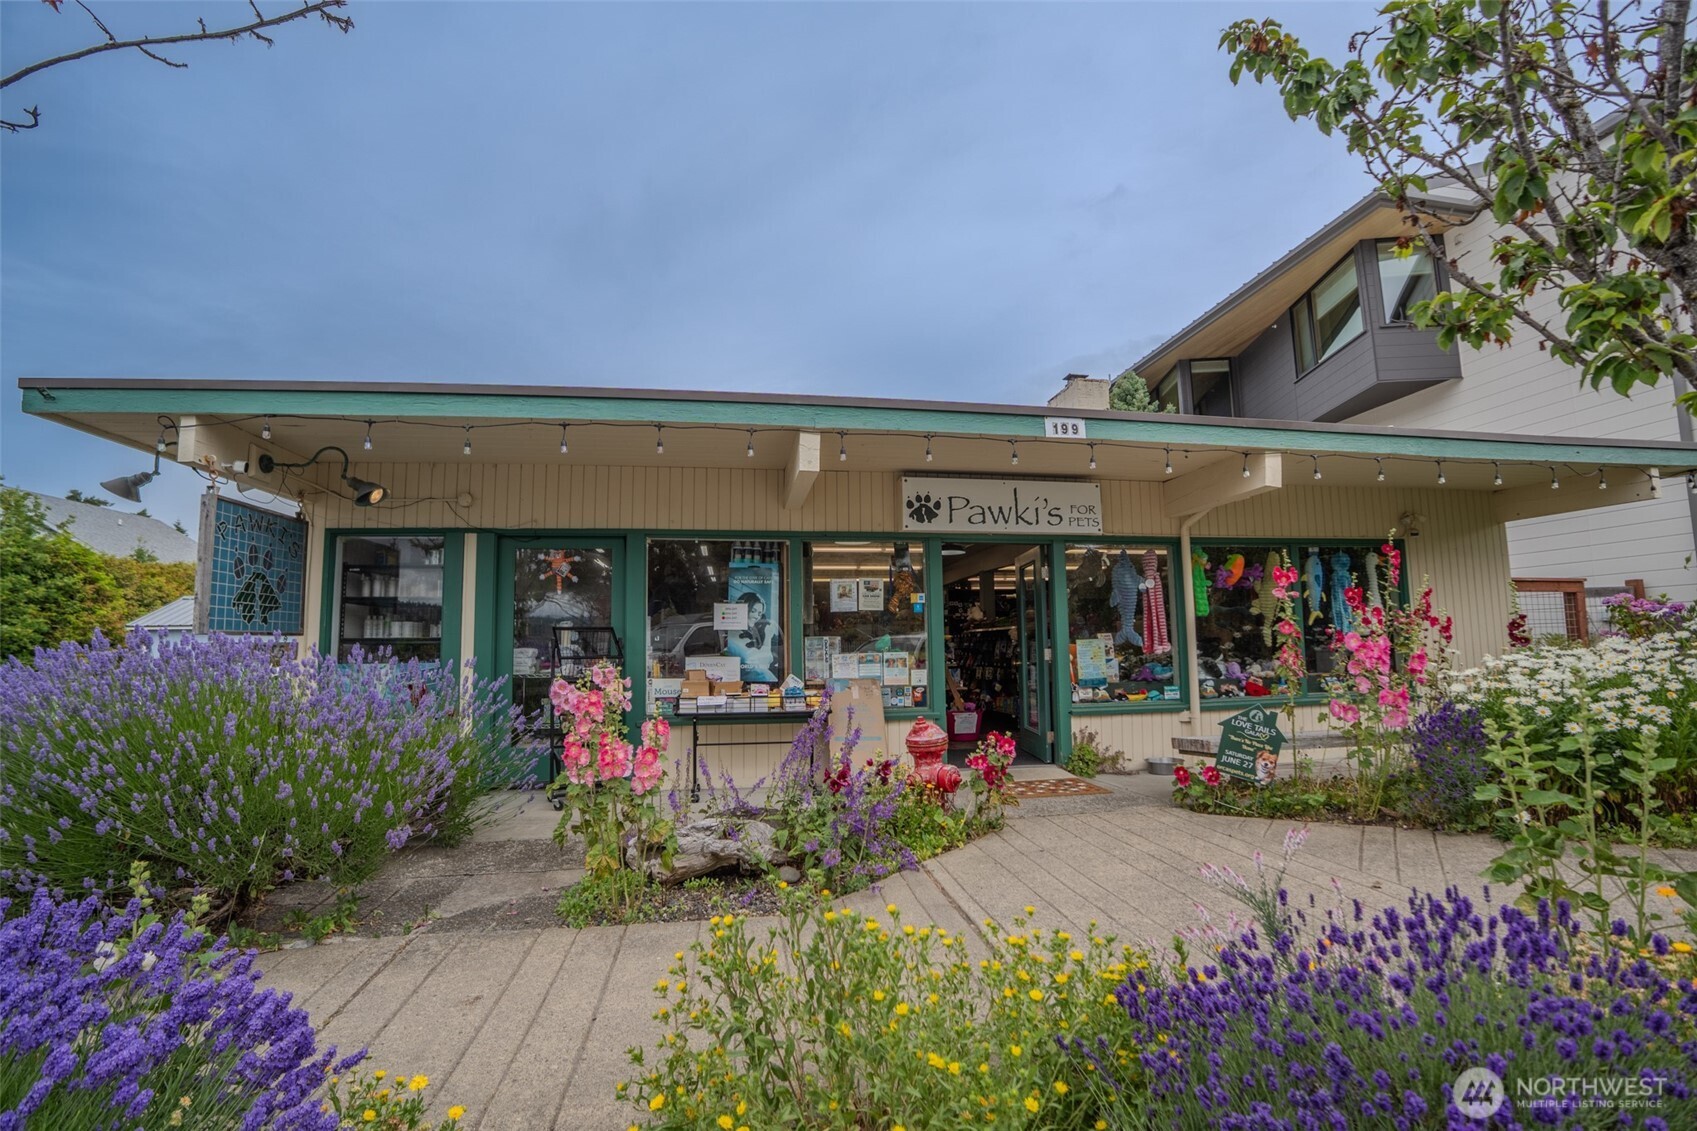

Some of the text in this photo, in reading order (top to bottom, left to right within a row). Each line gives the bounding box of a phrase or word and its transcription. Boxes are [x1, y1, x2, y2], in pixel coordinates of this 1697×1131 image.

[1052, 422, 1079, 435] 199
[947, 487, 1063, 526] Pawki's
[1069, 504, 1097, 515] FOR
[1068, 517, 1100, 528] PETS
[1231, 719, 1277, 736] LOVE TAILS
[1224, 749, 1254, 761] SATURDAY
[1221, 755, 1254, 769] JUNE 27
